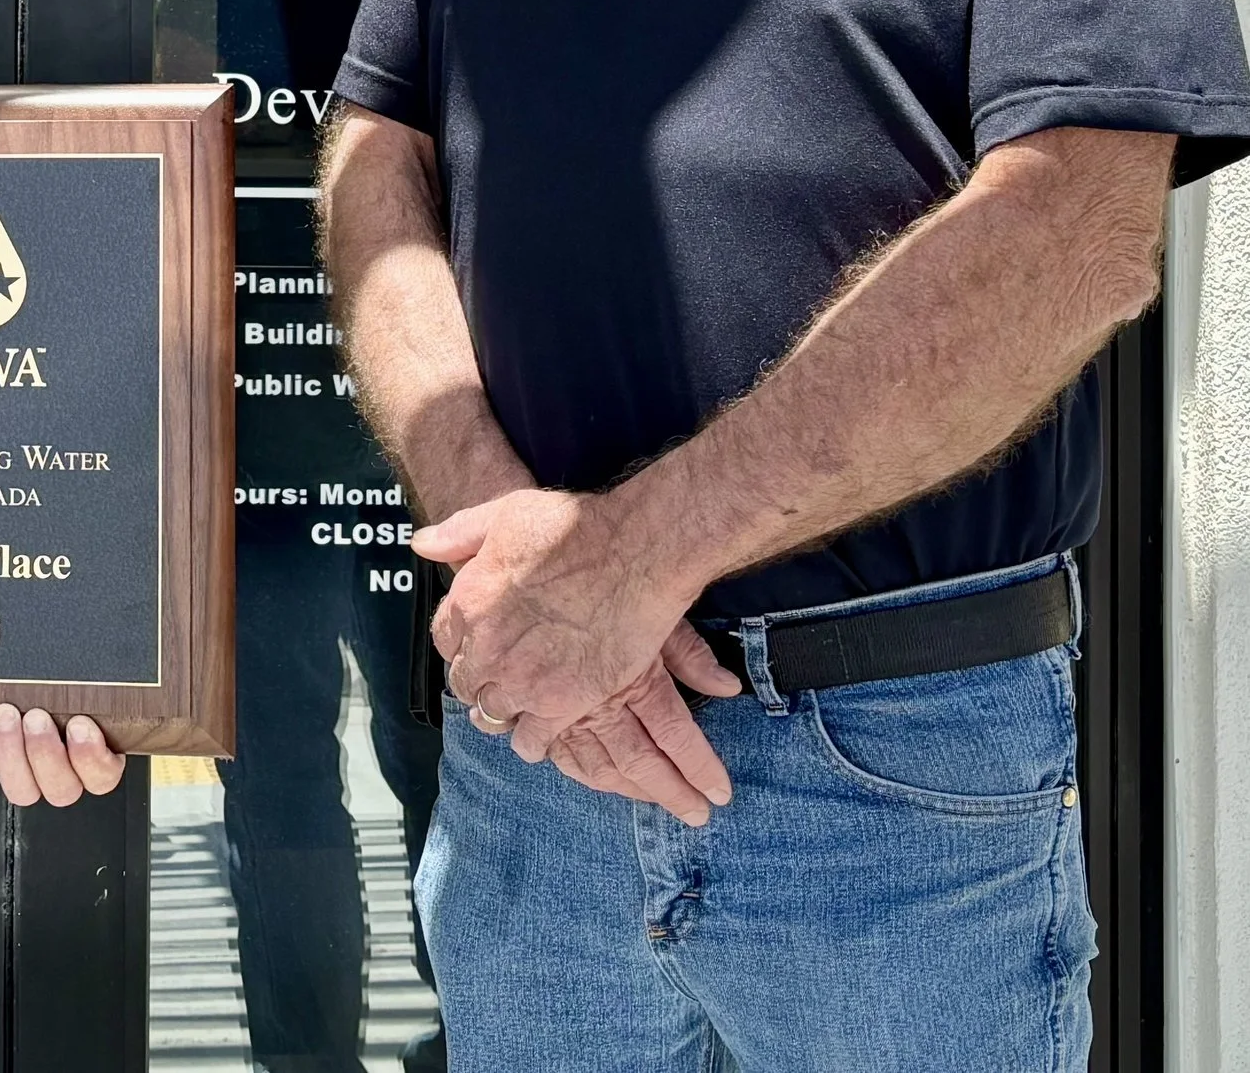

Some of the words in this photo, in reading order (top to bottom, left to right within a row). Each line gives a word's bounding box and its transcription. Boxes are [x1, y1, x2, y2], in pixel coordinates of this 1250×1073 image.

[21, 445, 111, 471] WATER
[320, 483, 407, 505] Mond
[311, 522, 412, 545] CLOSE
